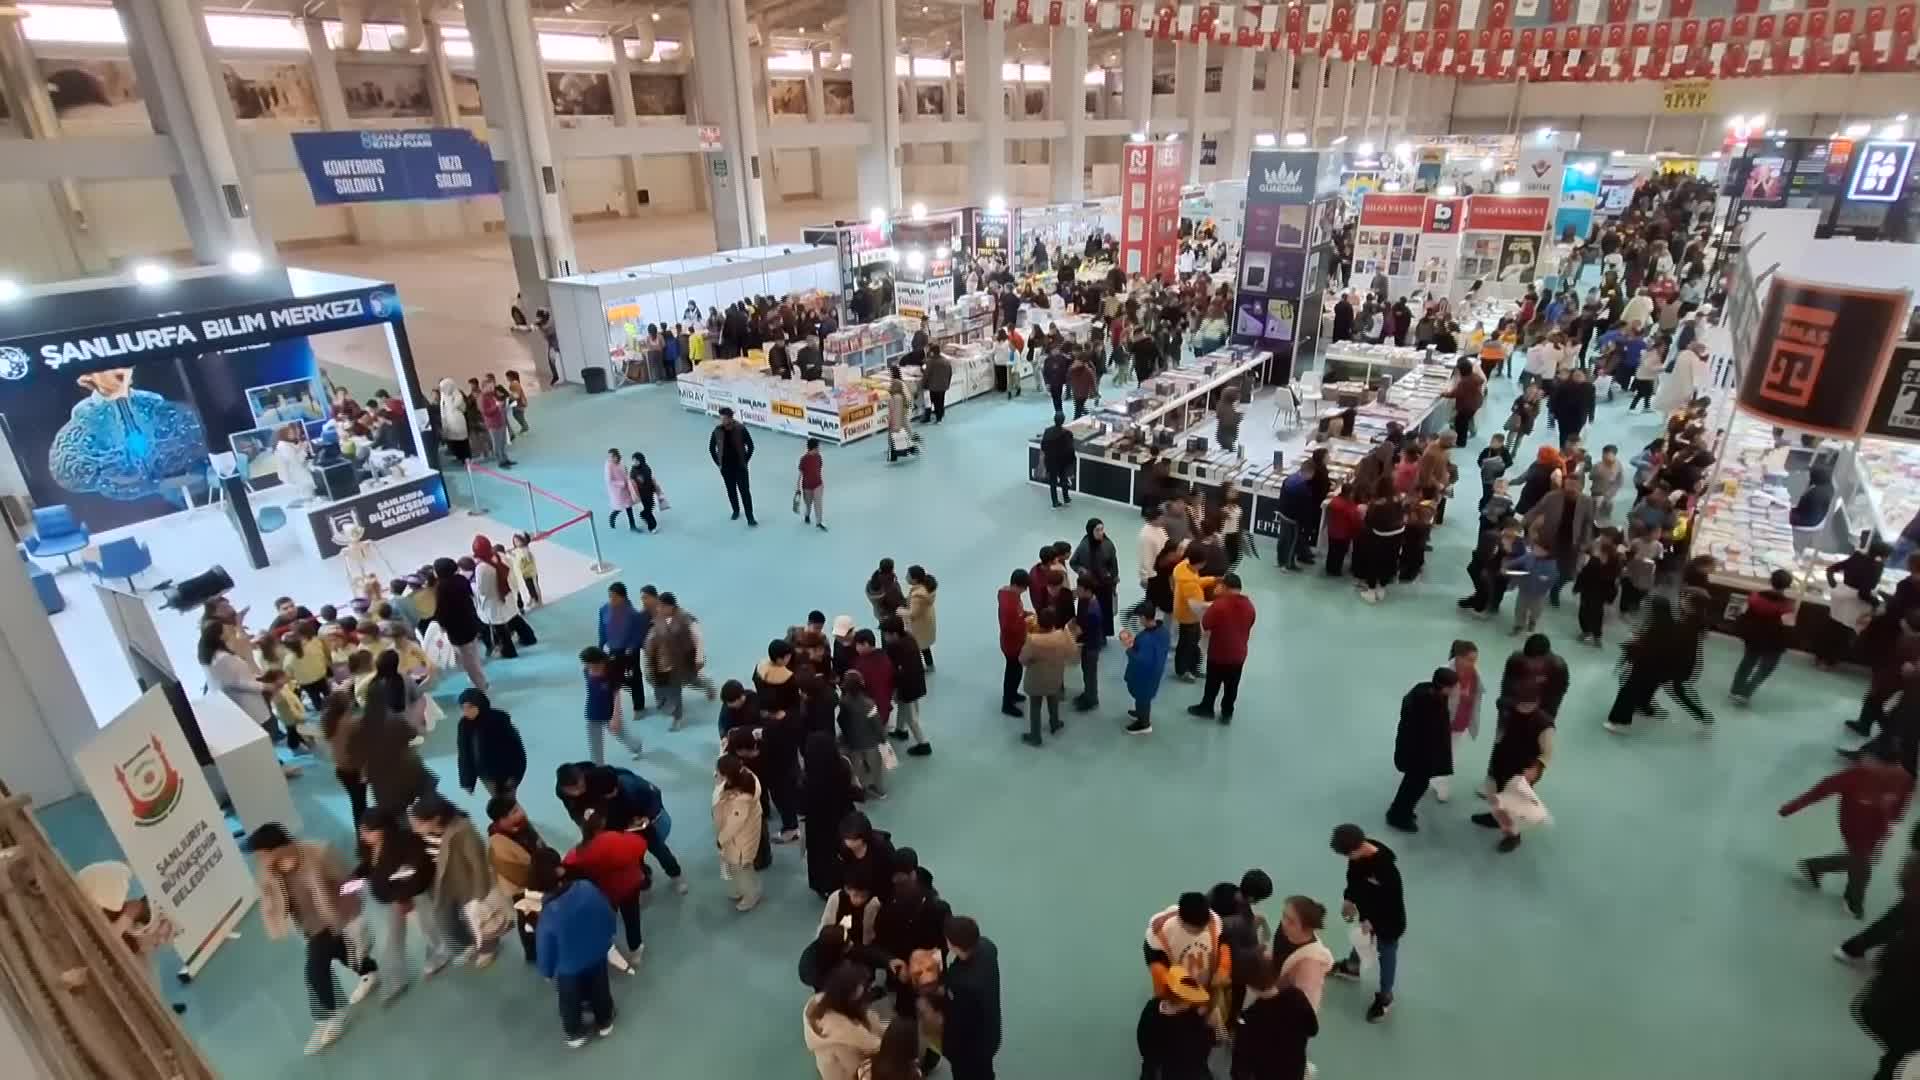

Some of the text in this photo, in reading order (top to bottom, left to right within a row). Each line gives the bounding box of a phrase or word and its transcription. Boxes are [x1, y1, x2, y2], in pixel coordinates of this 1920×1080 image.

[323, 159, 385, 177] KONFERANS
[334, 178, 376, 194] SALONU
[435, 173, 473, 188] SALONU
[40, 325, 197, 369] ŞANLIURFA
[156, 820, 209, 876] ŞANLIURFA
